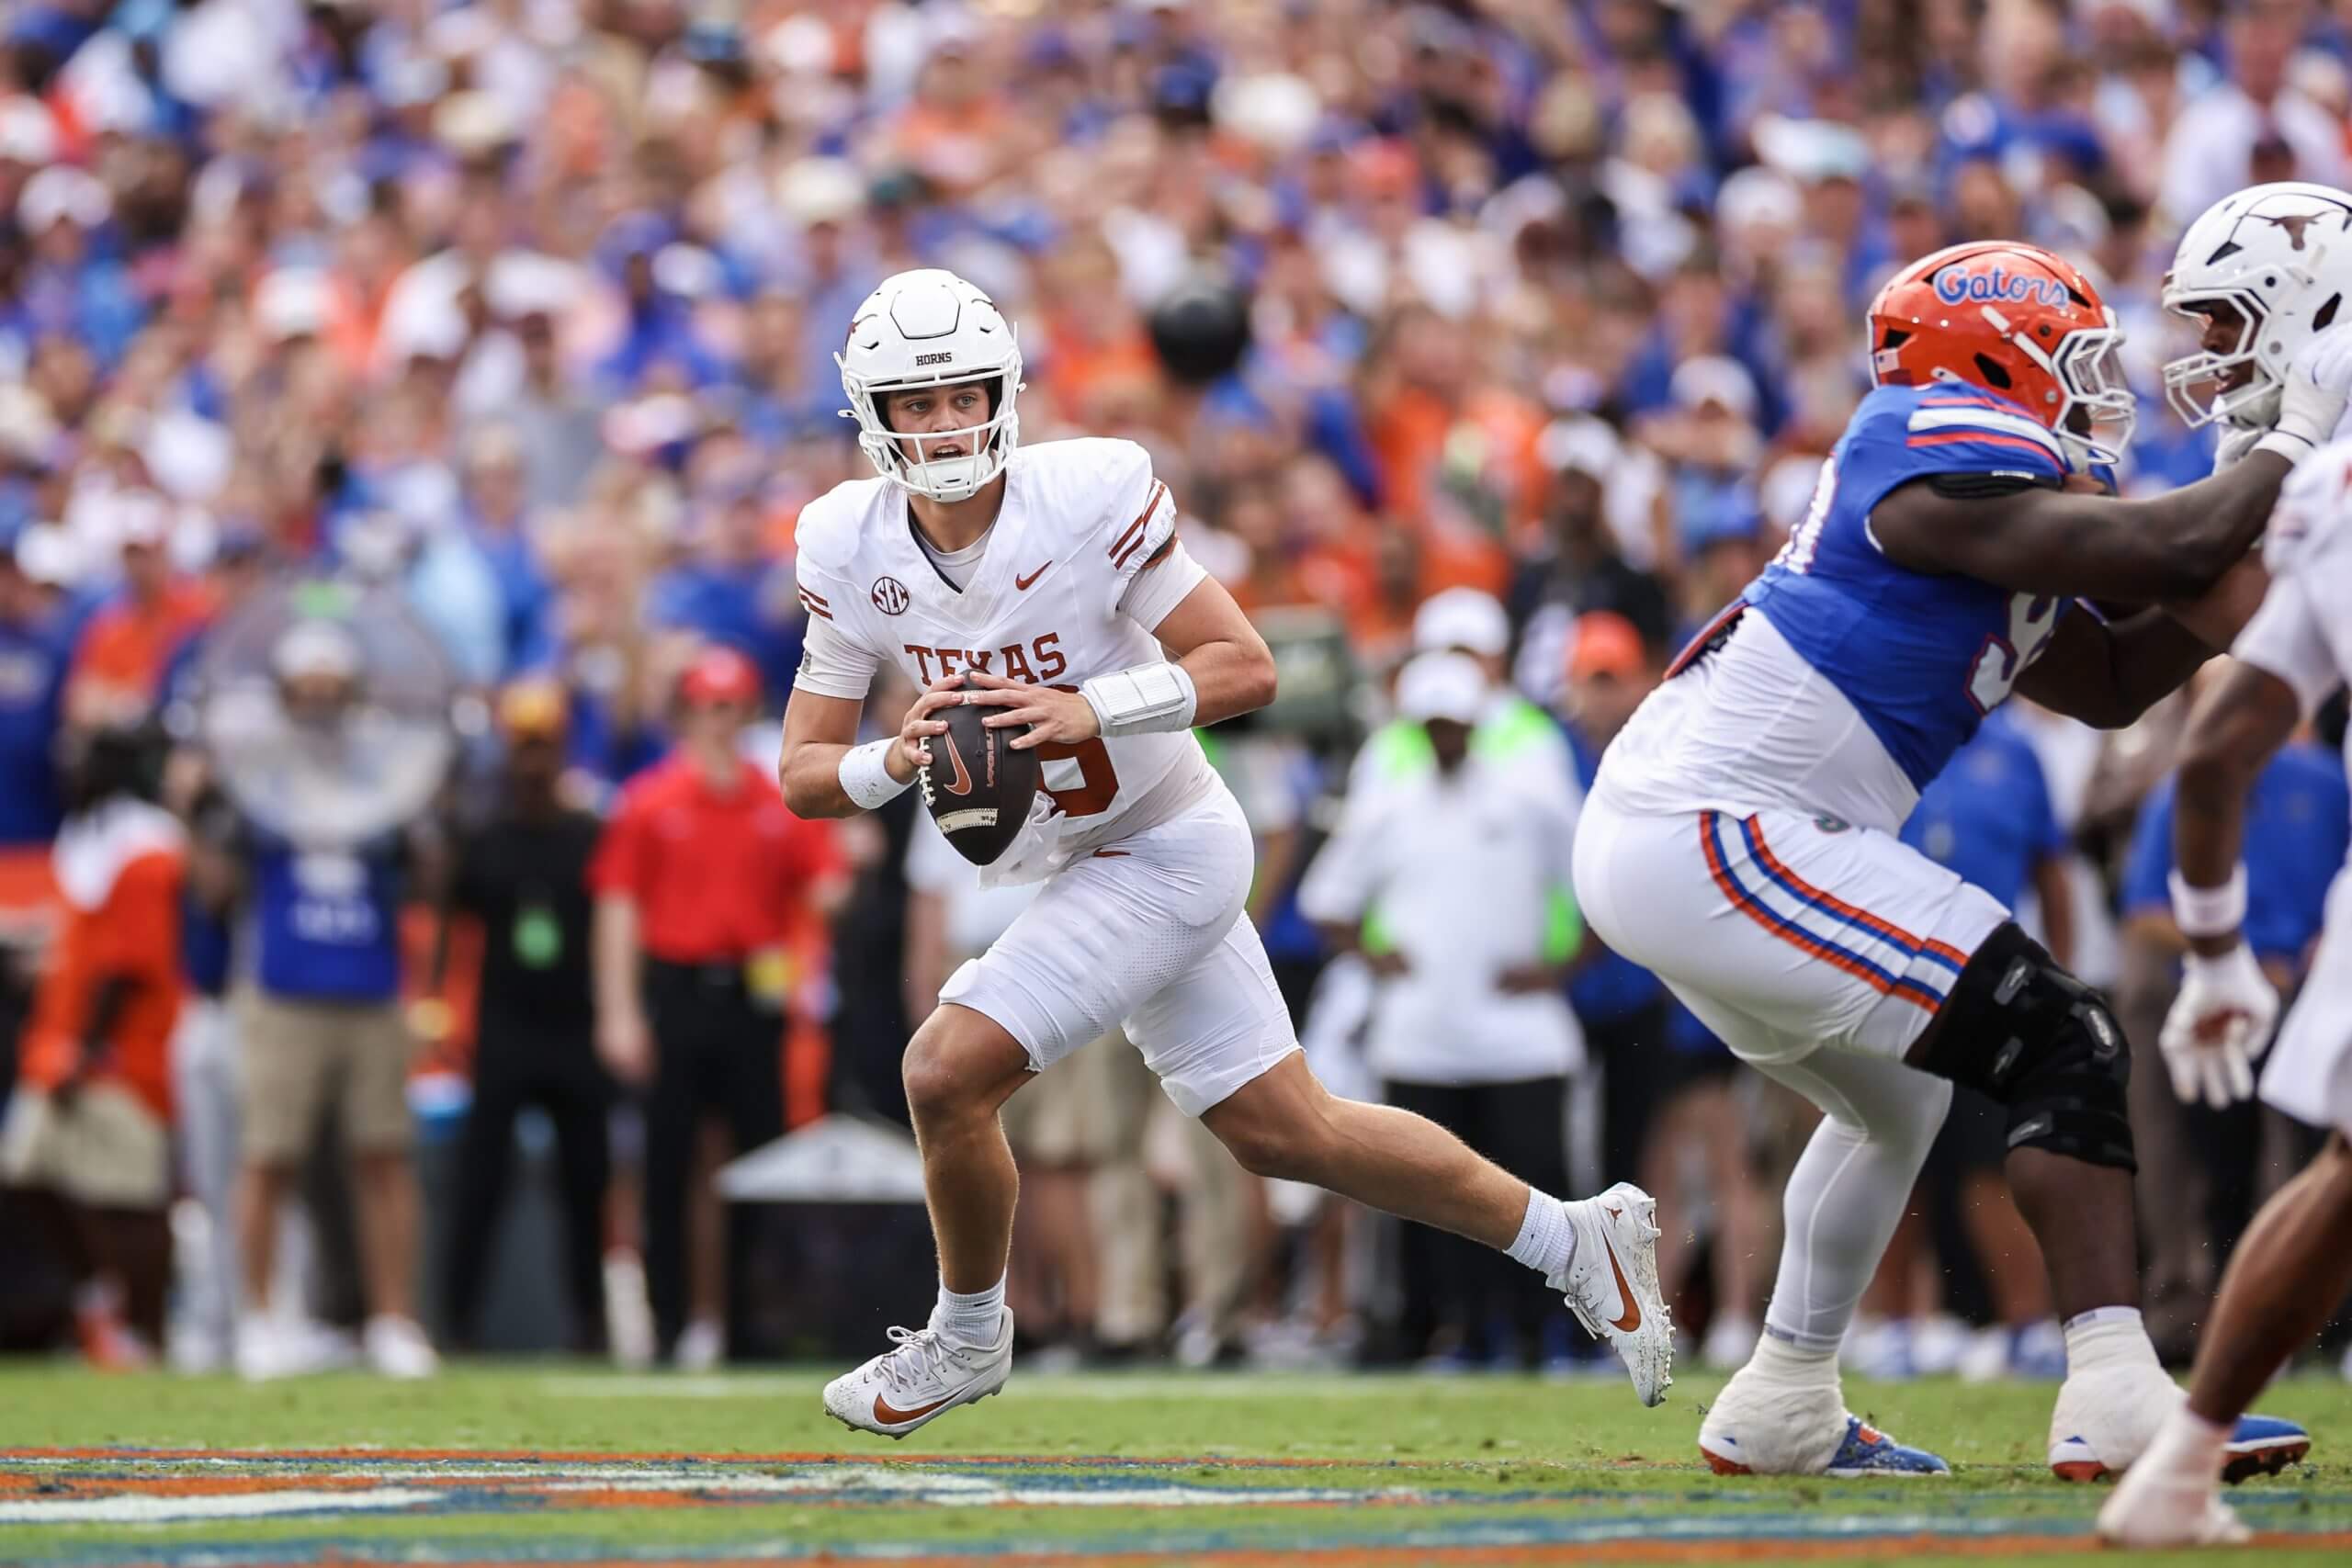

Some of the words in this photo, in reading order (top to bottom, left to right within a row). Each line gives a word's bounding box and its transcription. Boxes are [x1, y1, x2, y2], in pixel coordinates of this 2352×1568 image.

[1933, 265, 2071, 309] Gators
[915, 352, 952, 367] HORNS
[872, 577, 910, 615] SEC
[903, 632, 1067, 687] TEXAS
